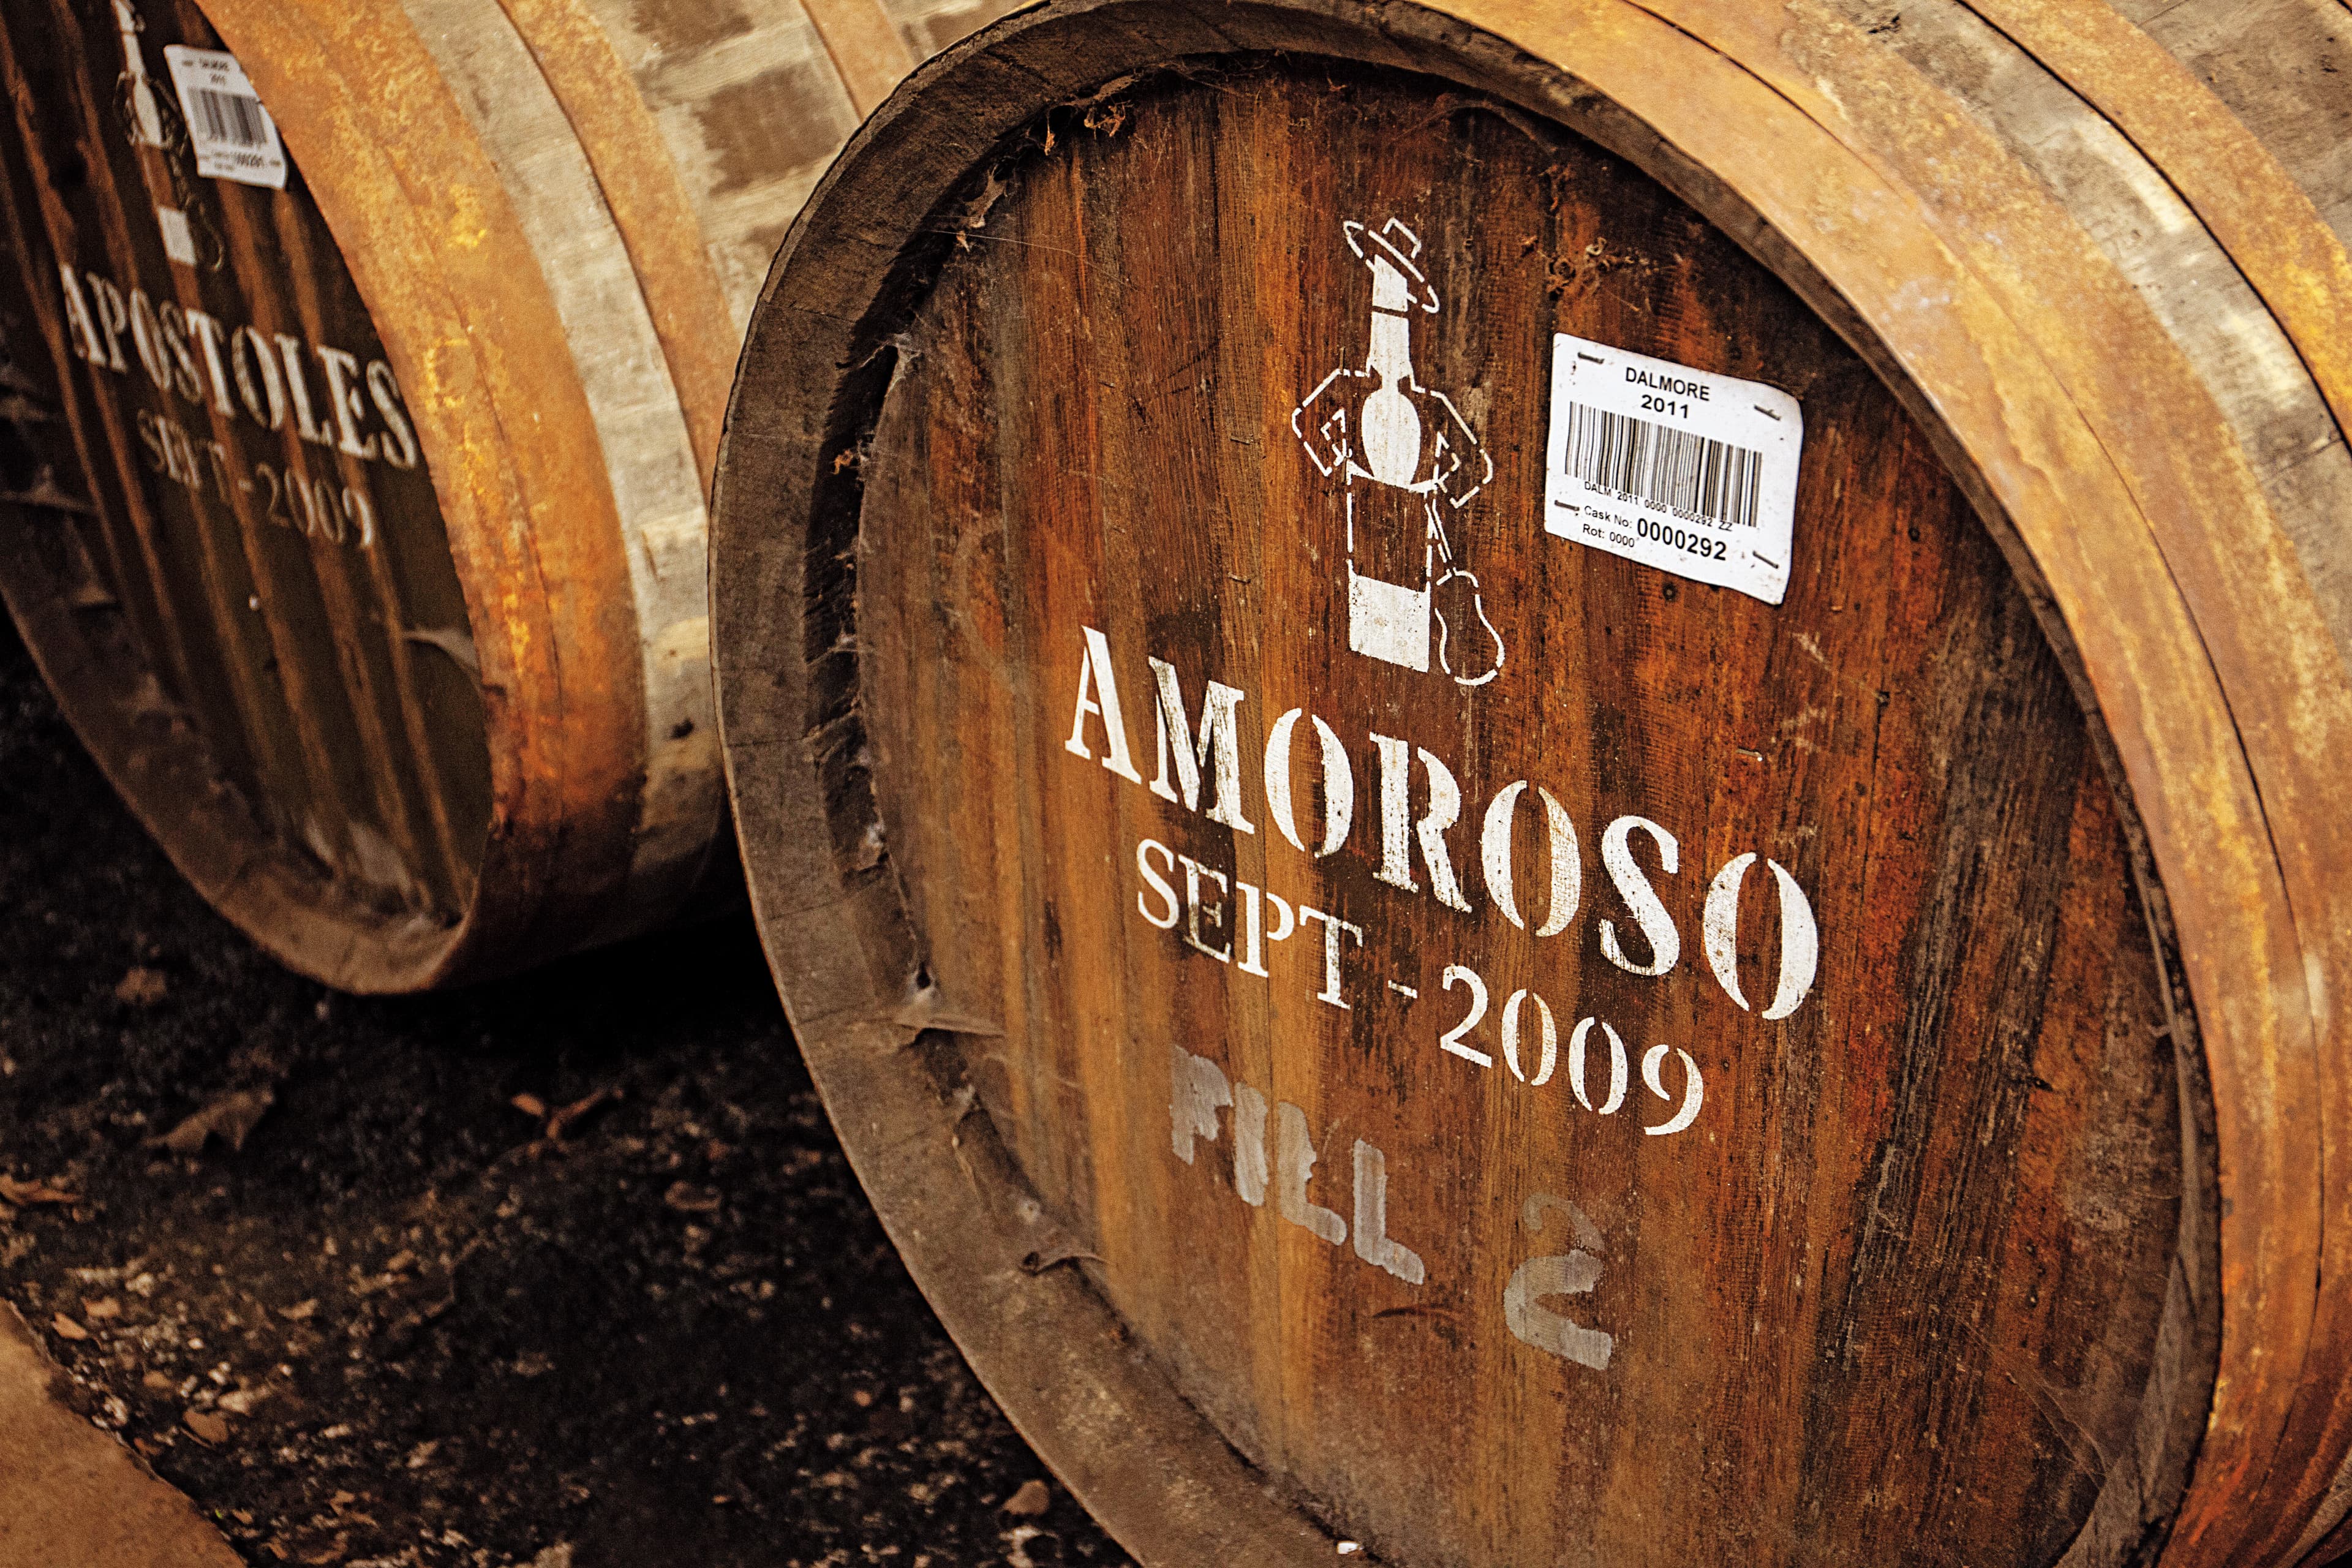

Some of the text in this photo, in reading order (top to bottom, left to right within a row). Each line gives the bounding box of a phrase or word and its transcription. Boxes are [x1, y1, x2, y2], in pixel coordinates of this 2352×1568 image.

[60, 263, 417, 470] APOSTOLES
[1626, 367, 1710, 402] DALMORE
[1641, 394, 1688, 419] 2011
[256, 463, 375, 550] 2009
[1583, 524, 1635, 548] Rot: 0000
[1584, 481, 1733, 532] DALM 2011 0000 0000292 ZZ
[1584, 505, 1727, 561] Cask No: 0000292
[1065, 624, 1819, 1020] AMOROSO
[1136, 839, 1363, 1009] SEPT
[1439, 964, 1704, 1136] 2009
[1169, 1044, 1425, 1285] FILL
